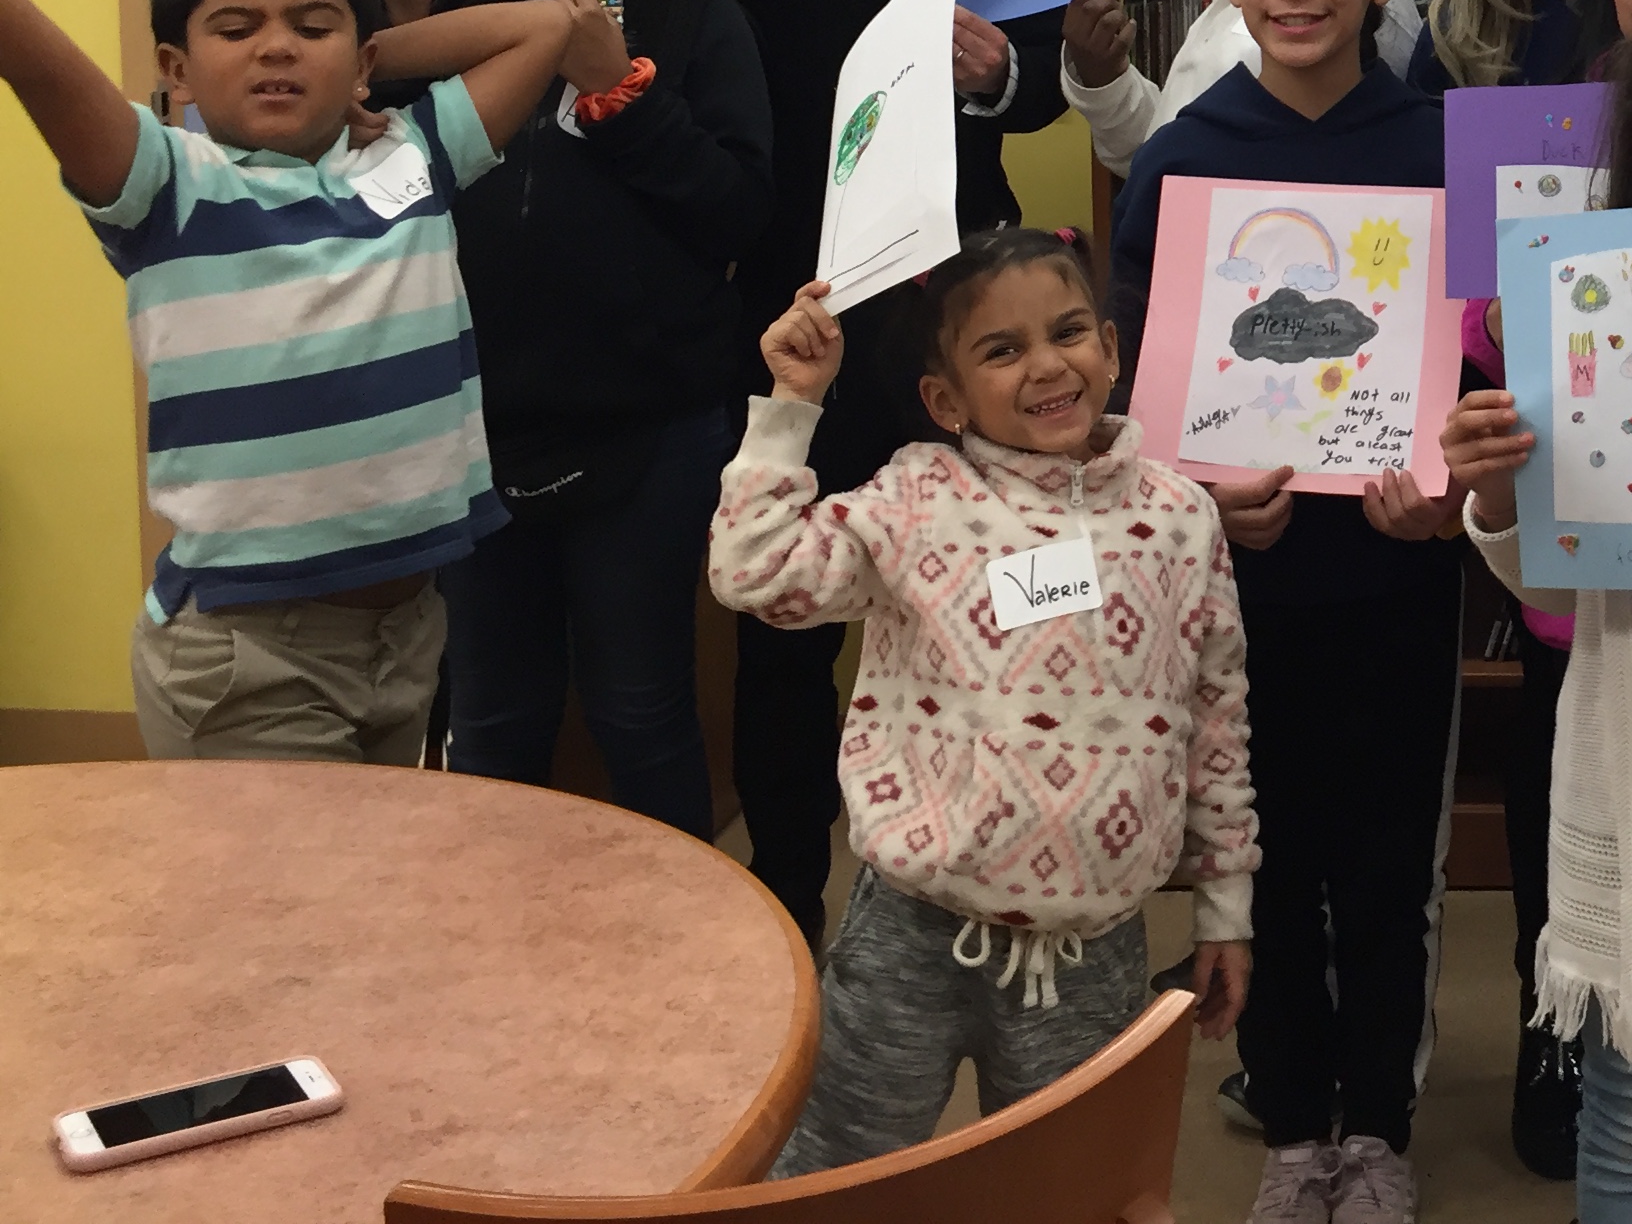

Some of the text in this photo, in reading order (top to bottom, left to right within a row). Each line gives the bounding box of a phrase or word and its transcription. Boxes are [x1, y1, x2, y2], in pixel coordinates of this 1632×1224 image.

[1391, 391, 1410, 404] all
[1335, 423, 1413, 441] are great
[1319, 436, 1340, 447] but
[1368, 454, 1404, 470] tried
